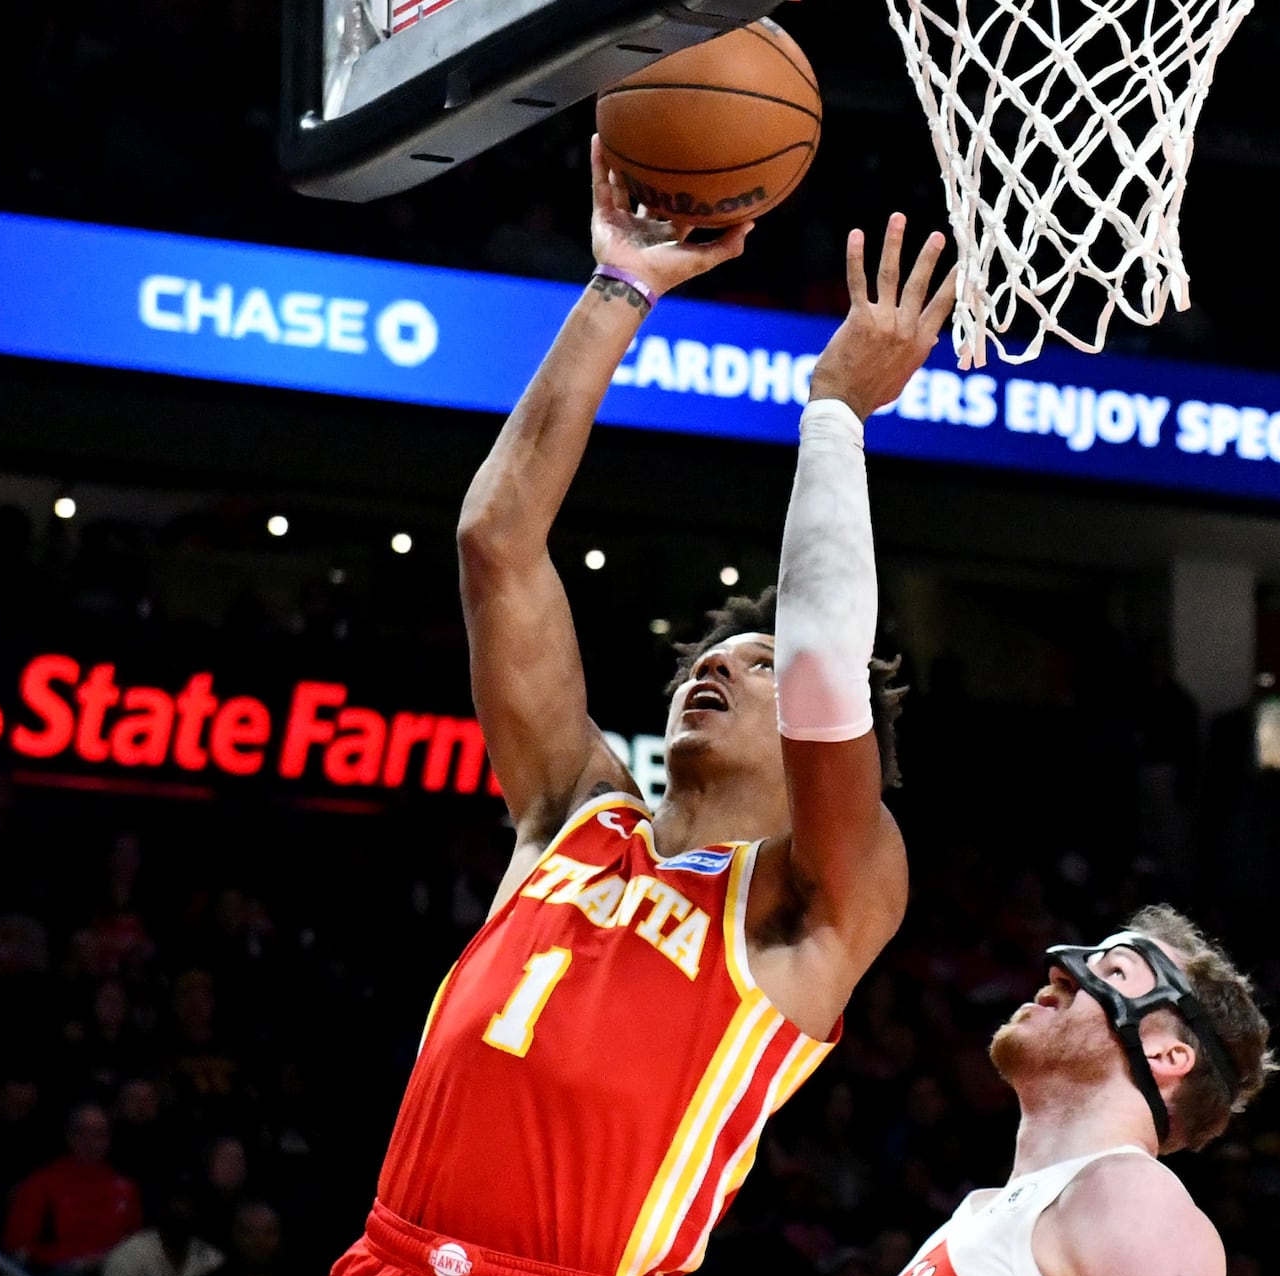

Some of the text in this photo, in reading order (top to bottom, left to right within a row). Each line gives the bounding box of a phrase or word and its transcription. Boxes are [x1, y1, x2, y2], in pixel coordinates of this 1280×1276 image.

[138, 274, 369, 354] CHASE
[609, 334, 997, 427] ARDHERS
[1005, 379, 1170, 451] ENJOY
[11, 653, 271, 777] State
[278, 680, 505, 798] Farm
[520, 853, 712, 983] TLANTA
[481, 945, 573, 1058] 1
[428, 1249, 473, 1276] HAWKS
